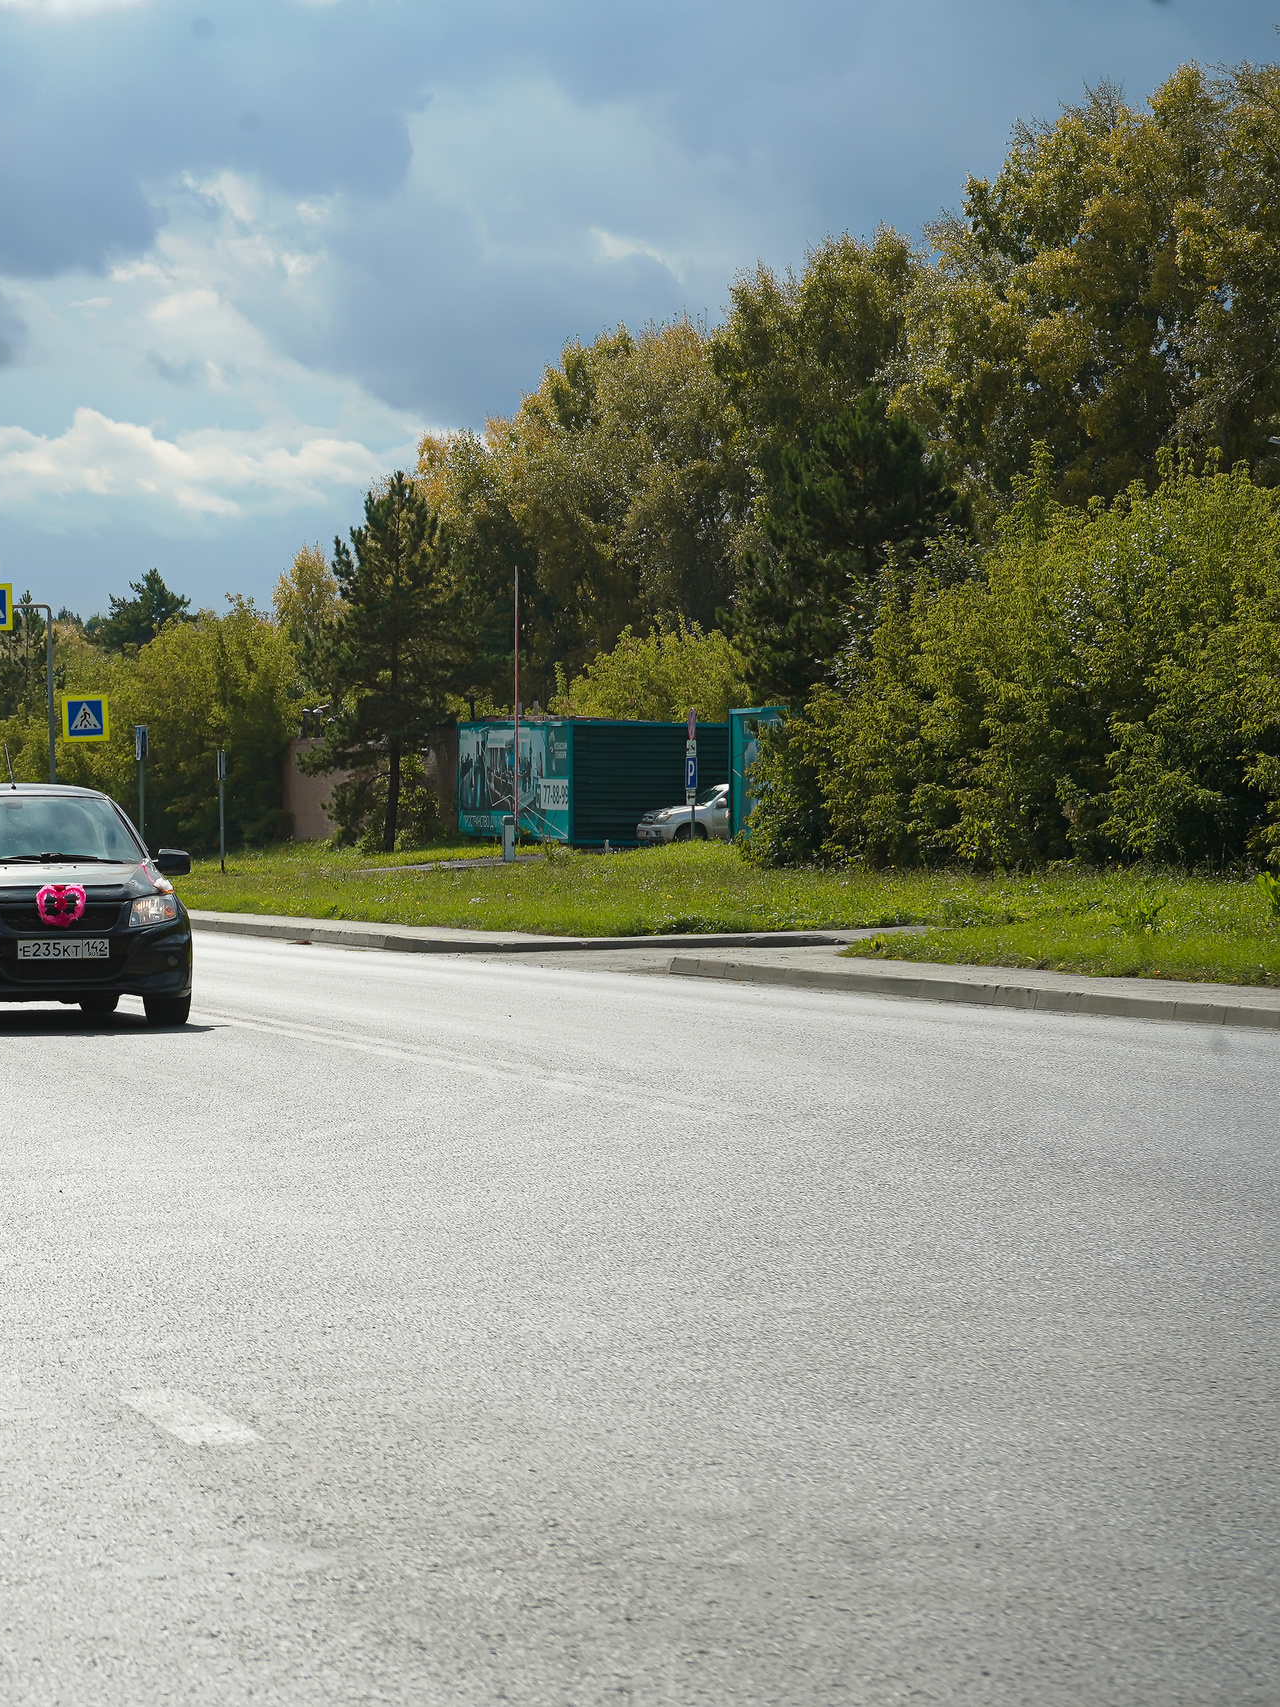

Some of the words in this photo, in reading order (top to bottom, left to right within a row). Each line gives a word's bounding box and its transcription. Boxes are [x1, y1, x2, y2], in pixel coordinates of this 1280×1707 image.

[687, 760, 695, 786] P
[22, 942, 81, 957] Е235КТ
[84, 940, 106, 952] 142
